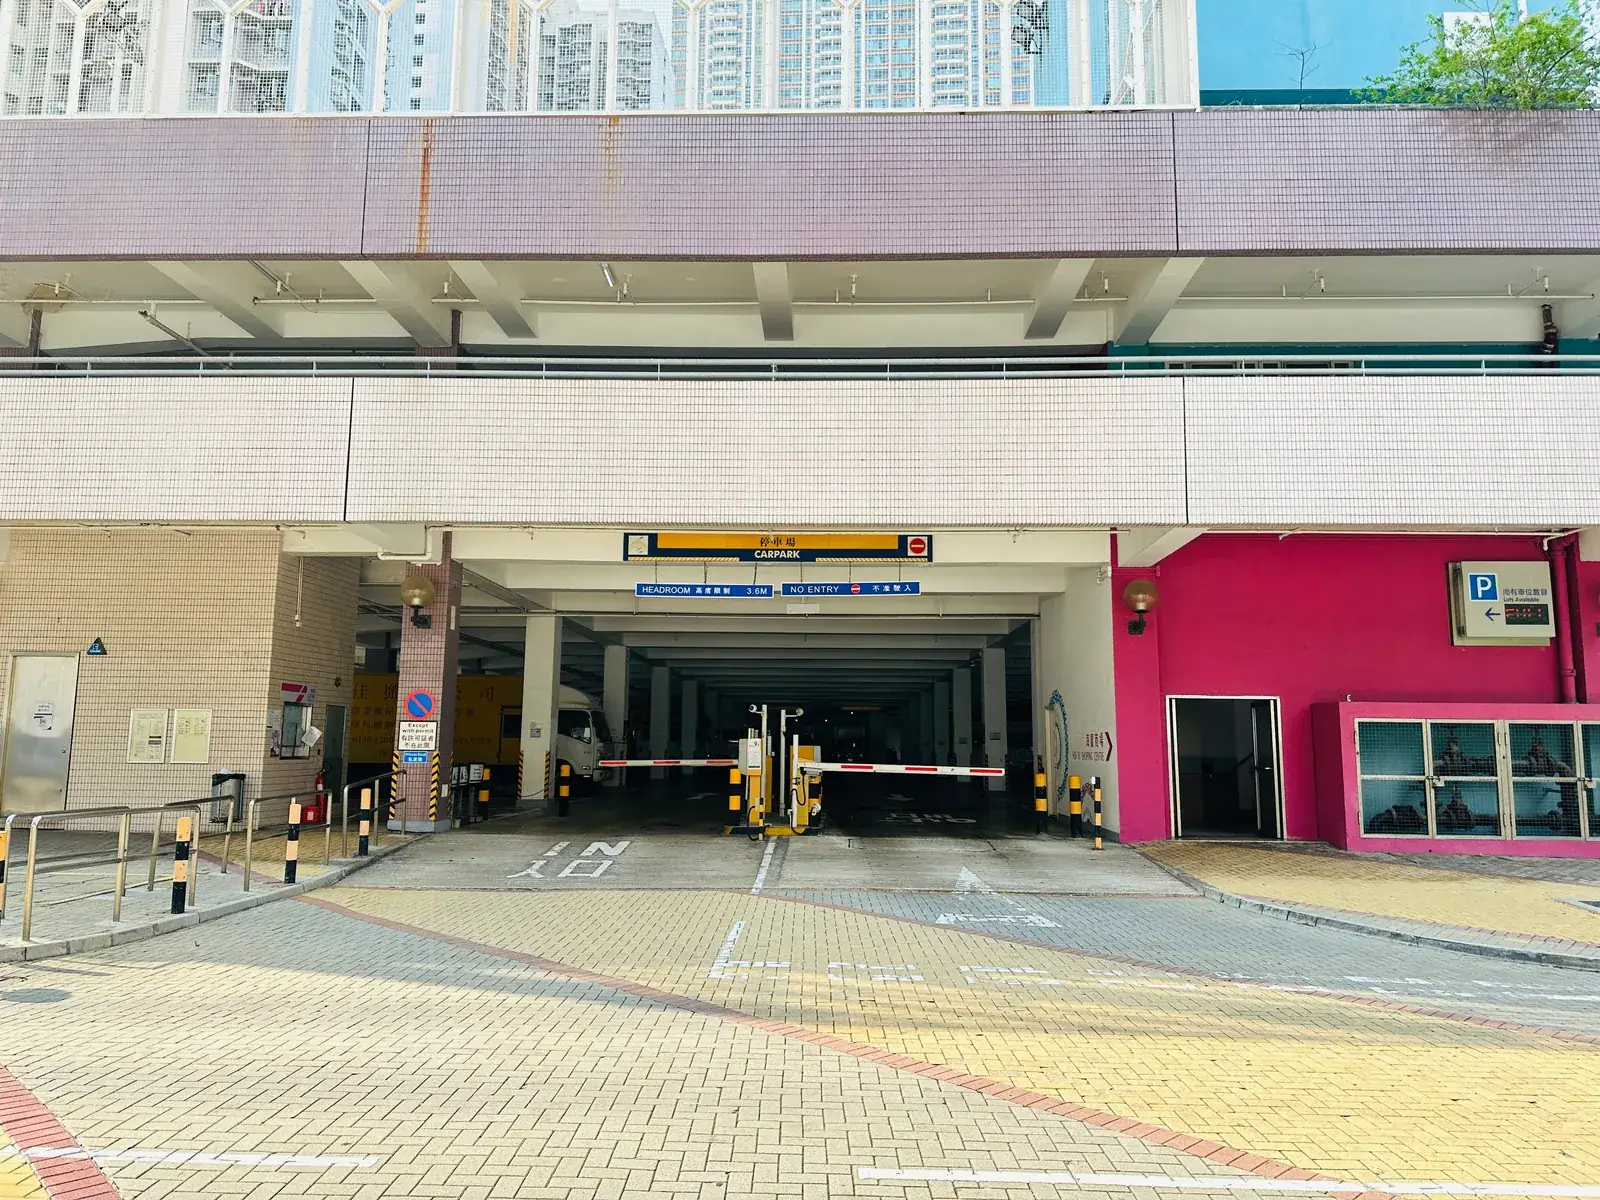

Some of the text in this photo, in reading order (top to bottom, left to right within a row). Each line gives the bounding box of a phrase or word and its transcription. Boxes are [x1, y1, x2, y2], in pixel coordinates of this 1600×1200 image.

[754, 550, 800, 559] CARPARK
[642, 586, 691, 594] HEADROOM
[790, 585, 804, 593] NO
[807, 585, 840, 594] ENTRY
[1476, 576, 1492, 598] P
[543, 841, 631, 856] IN
[506, 860, 615, 878] 入口
